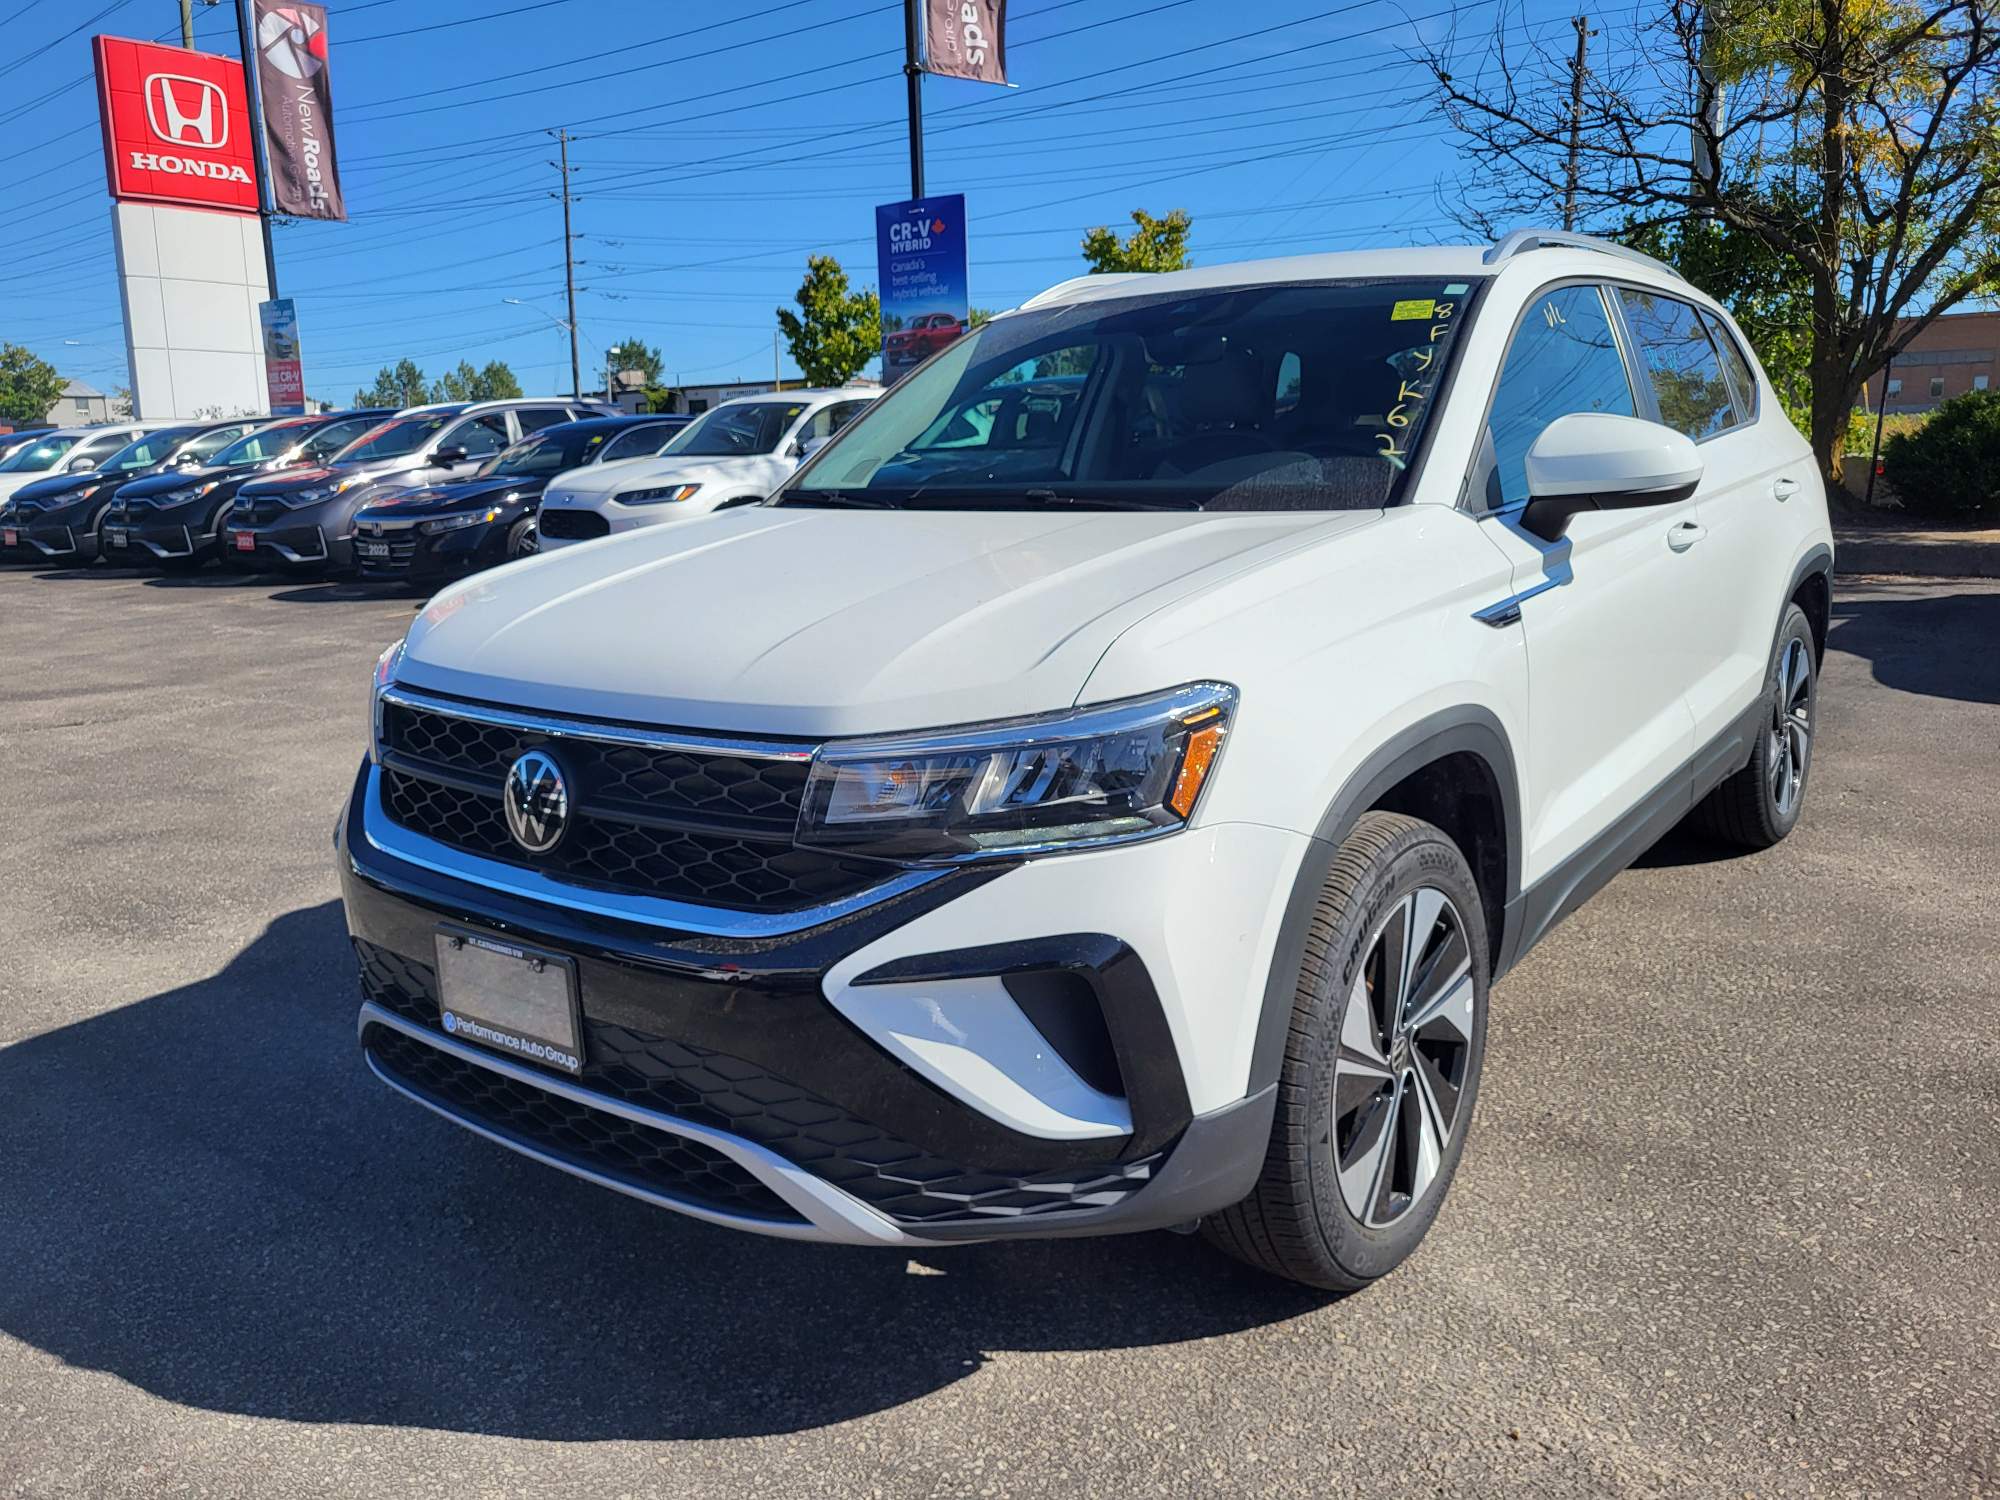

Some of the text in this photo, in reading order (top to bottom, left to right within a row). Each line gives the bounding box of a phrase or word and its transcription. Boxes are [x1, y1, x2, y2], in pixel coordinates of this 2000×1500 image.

[130, 151, 252, 184] HONDA
[890, 219, 931, 241] CR-V
[891, 238, 931, 254] HYBRID
[891, 259, 925, 273] Canada's
[367, 544, 389, 555] 2022
[456, 1016, 578, 1071] Performance Auto Group
